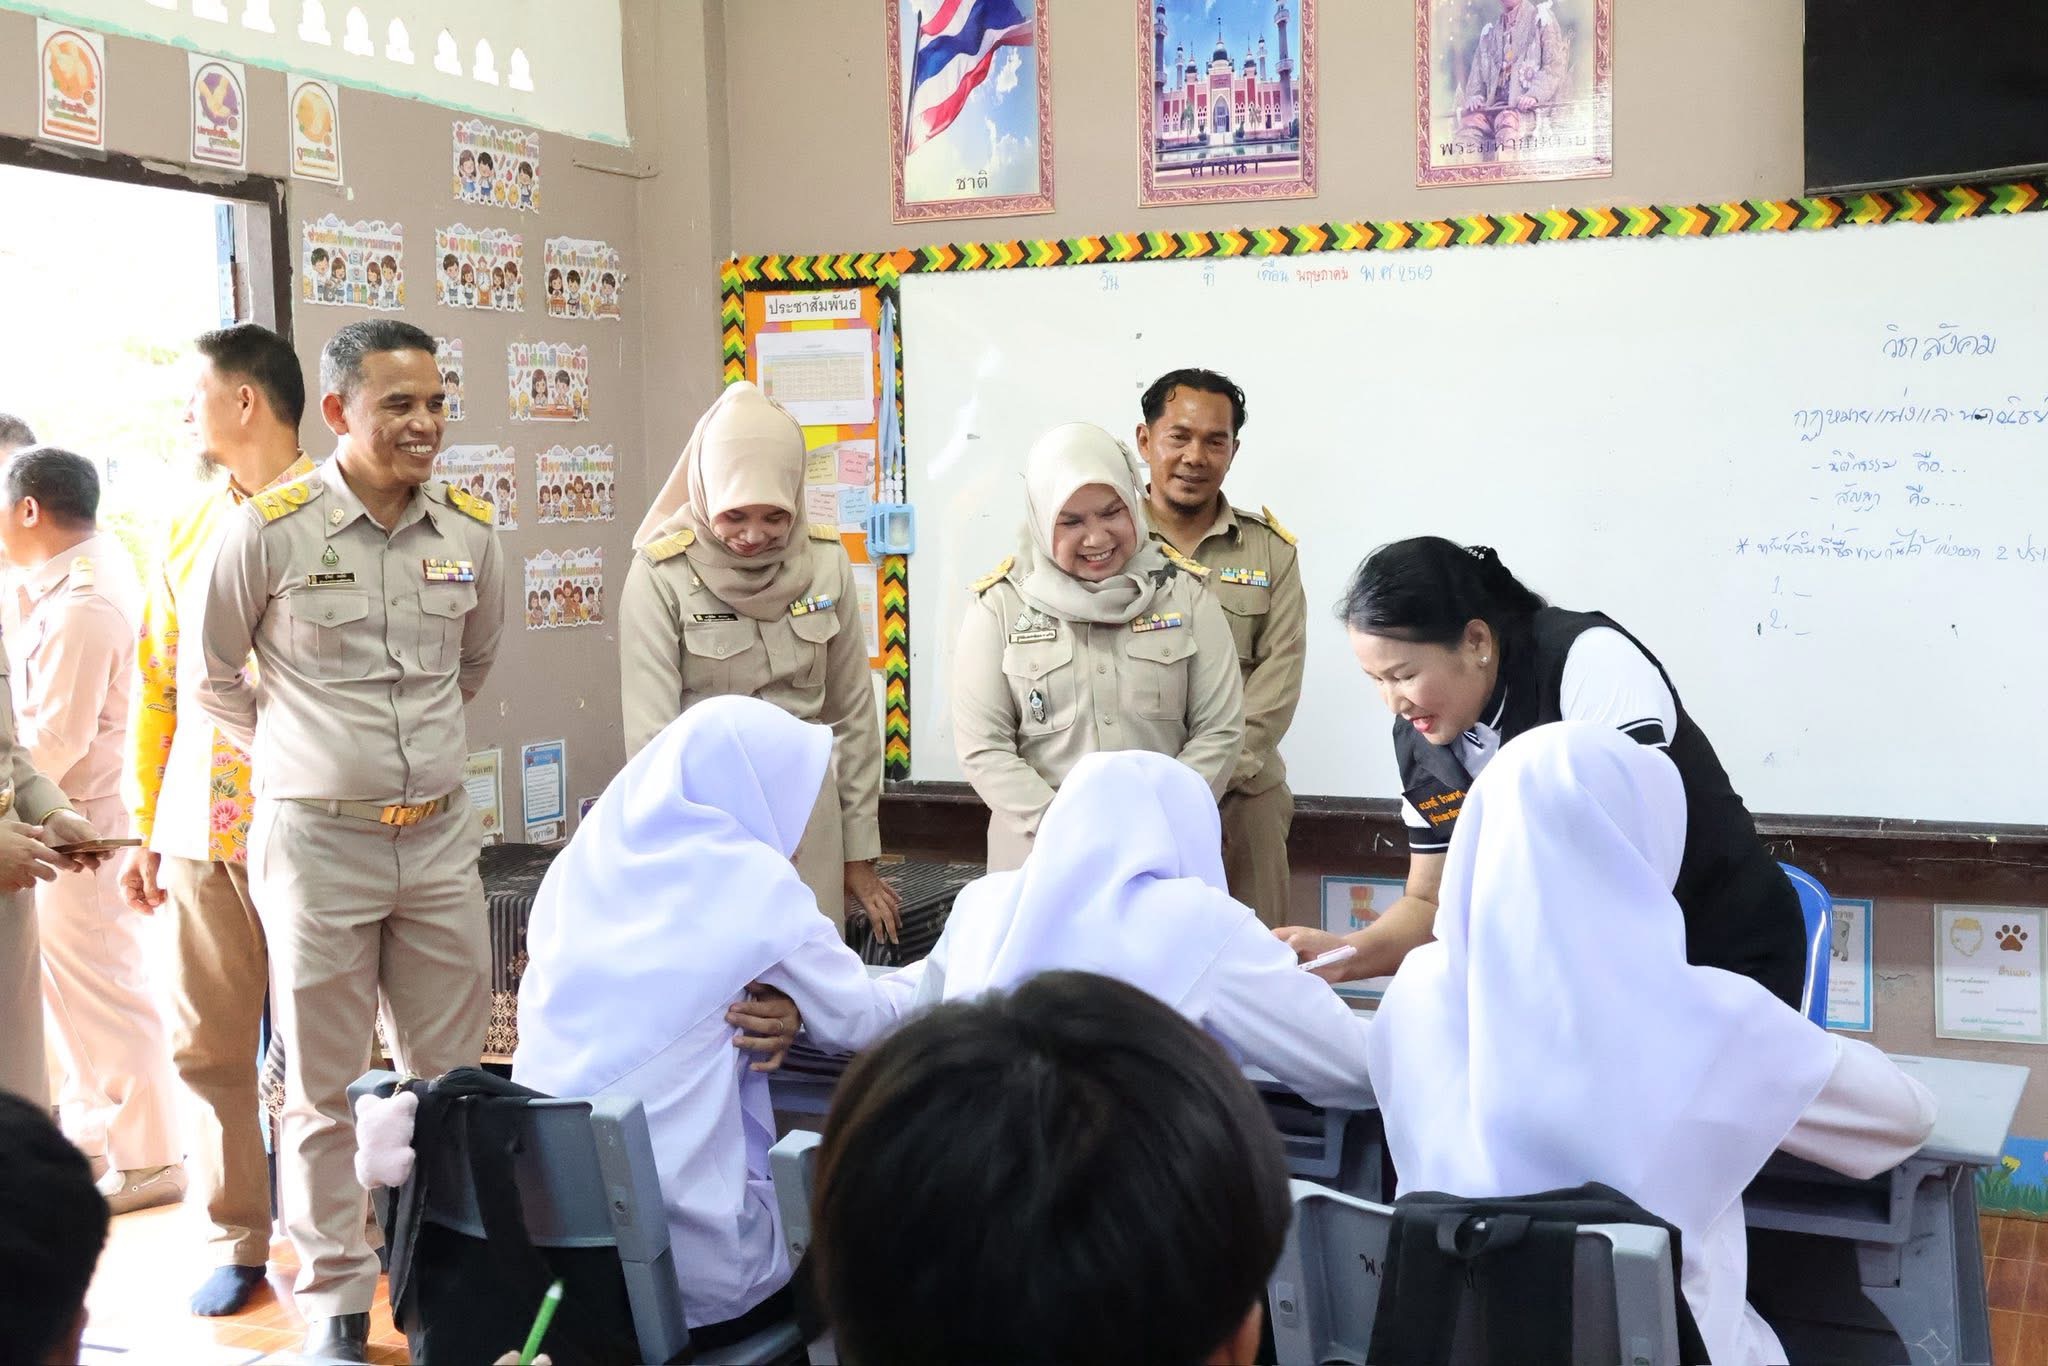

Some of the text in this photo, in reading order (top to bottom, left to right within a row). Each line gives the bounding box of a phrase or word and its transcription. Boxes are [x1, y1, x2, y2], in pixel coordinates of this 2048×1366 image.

[1190, 158, 1260, 178] ศาสนา
[956, 169, 988, 190] ชาติ
[448, 236, 514, 258] ตรงต่อเวลา
[1099, 270, 1119, 290] วัน
[768, 290, 858, 315] ประชาสัมพันธ์
[514, 345, 586, 370] ไม่ส่งเสียงดัง
[1996, 545, 2009, 560] 2
